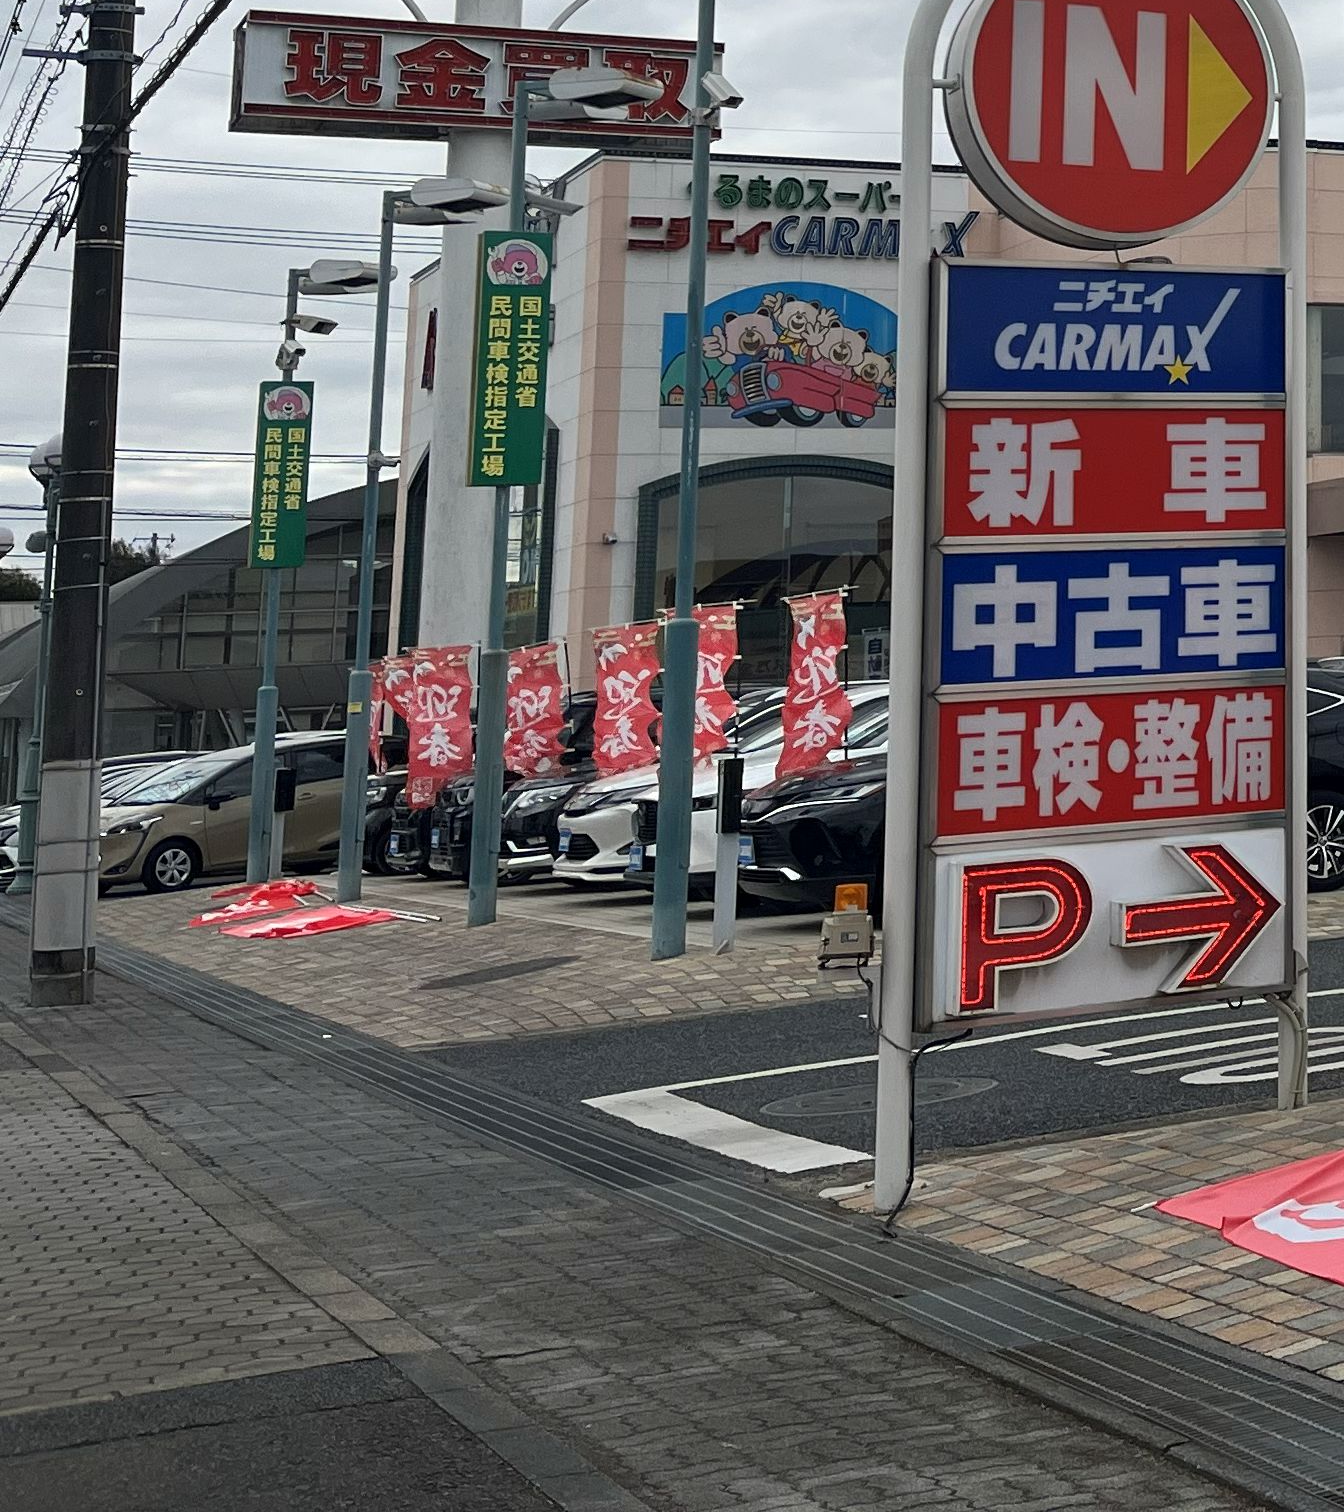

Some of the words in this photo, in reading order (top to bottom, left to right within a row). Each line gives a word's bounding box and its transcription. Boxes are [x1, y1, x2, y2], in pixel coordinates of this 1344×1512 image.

[687, 172, 900, 214] るまのスーパ
[769, 210, 980, 259] CARMX
[514, 295, 543, 408] 国土交通省
[994, 288, 1240, 374] CARMAX
[1053, 279, 1176, 314] ニチエイ
[480, 295, 513, 477] 民間車検指定工場
[257, 427, 284, 561] 民間車検指定工場
[283, 427, 307, 510] 国土交通省
[967, 416, 1268, 529] 新車
[951, 558, 1278, 678] 中古車
[953, 691, 1274, 822] 車検・整備
[955, 856, 1093, 1015] P
